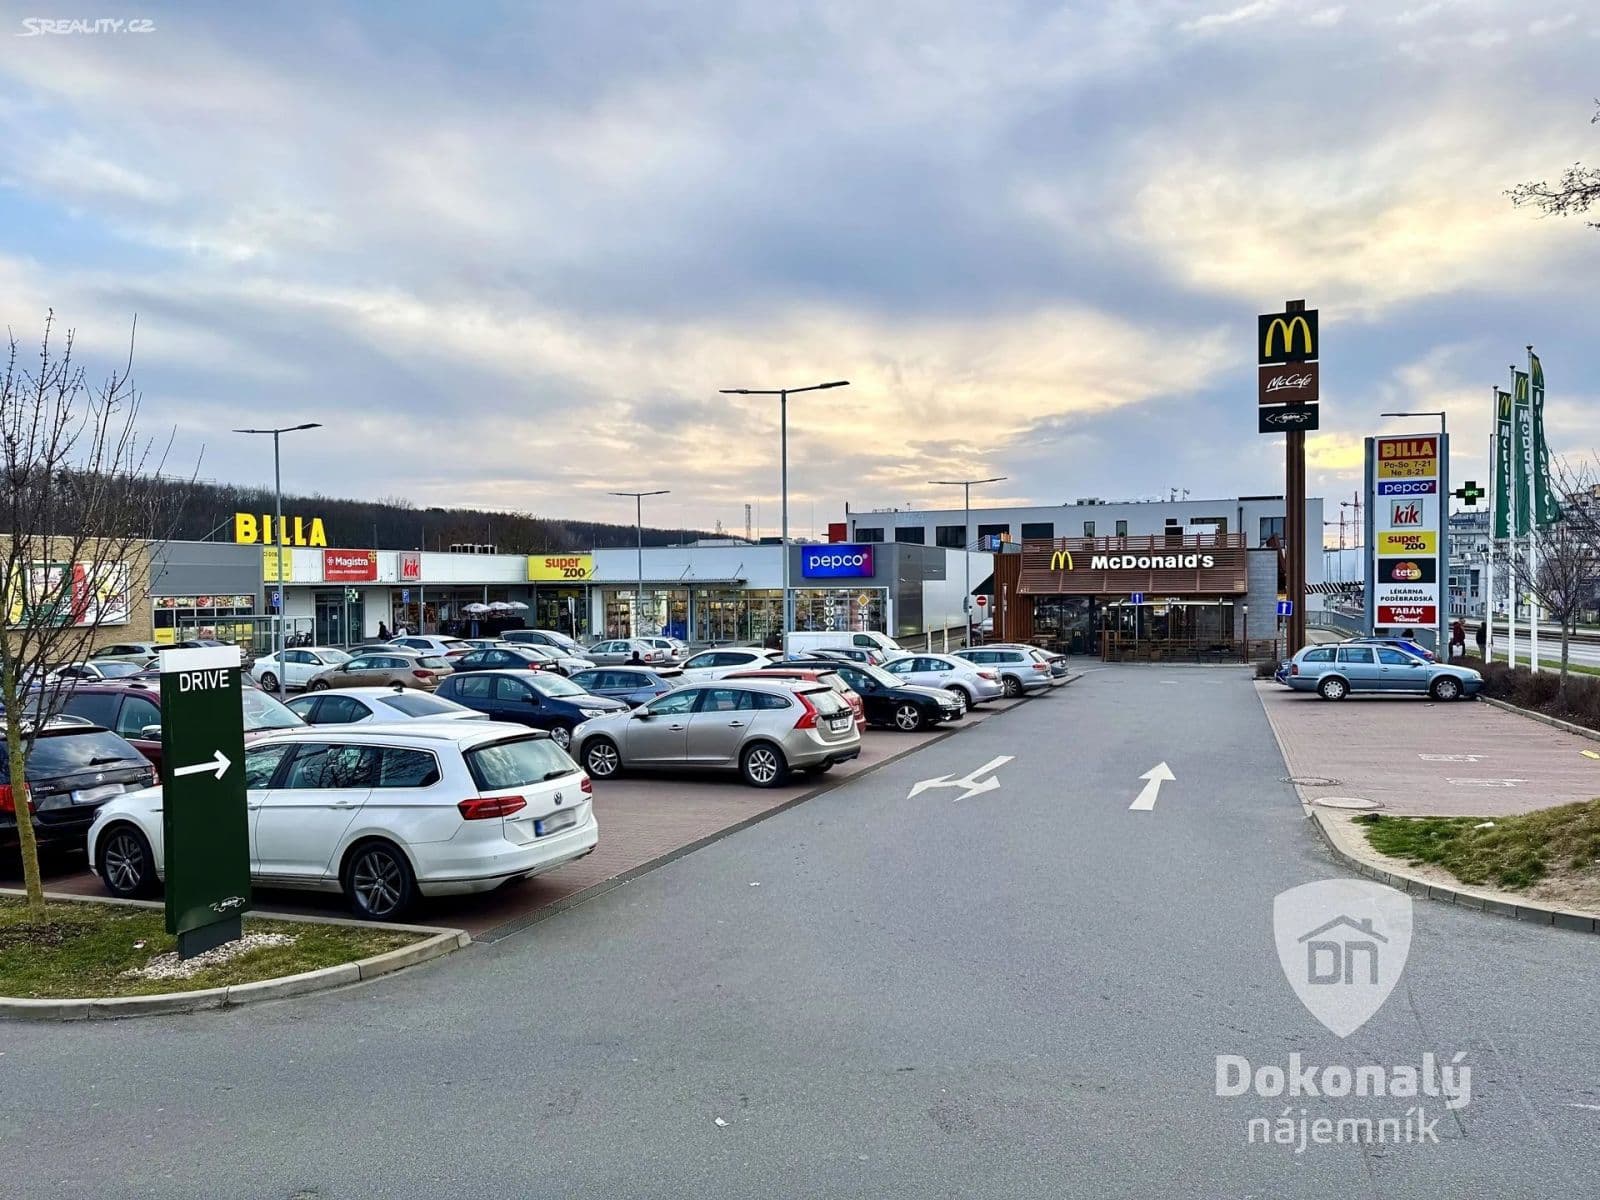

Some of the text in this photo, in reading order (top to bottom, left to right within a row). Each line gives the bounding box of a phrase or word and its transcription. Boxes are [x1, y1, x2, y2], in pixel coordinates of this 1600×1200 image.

[1382, 441, 1434, 457] BILLA
[1385, 483, 1429, 494] pepco
[236, 513, 327, 546] BILLA
[1387, 535, 1421, 545] super
[335, 556, 368, 567] Magistra
[545, 558, 581, 570] super
[810, 554, 864, 569] pepco
[1091, 554, 1215, 570] McDonald's
[563, 568, 586, 578] zoo
[179, 669, 230, 692] DRIVE
